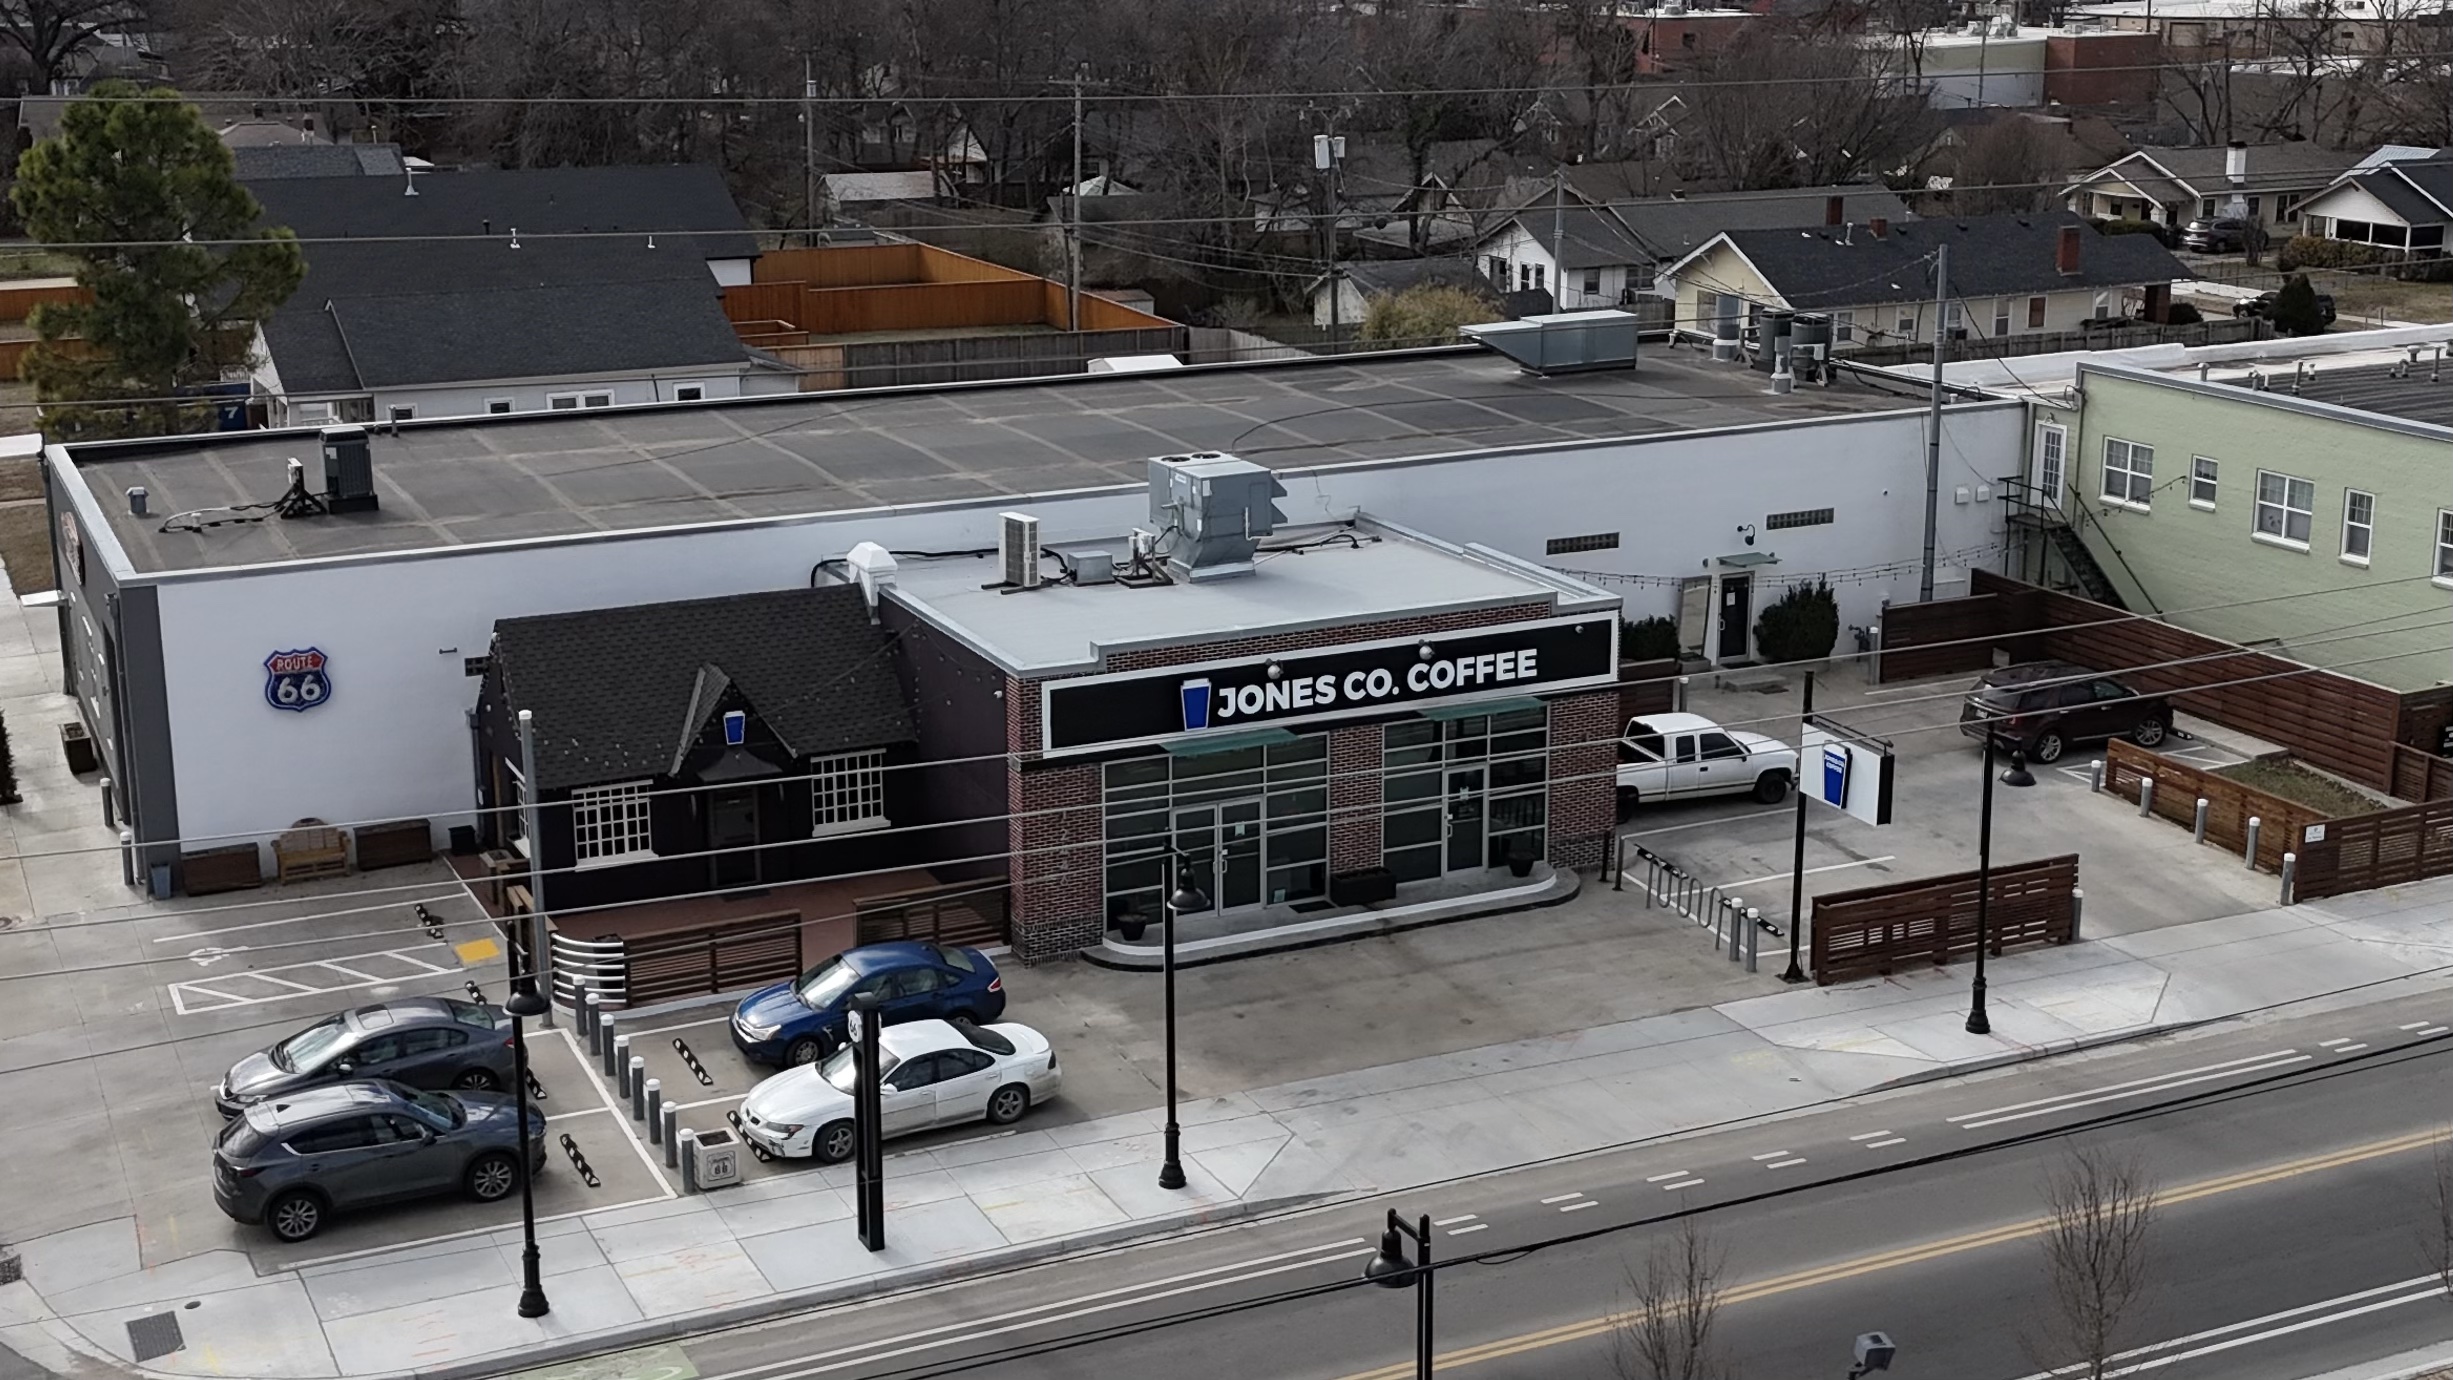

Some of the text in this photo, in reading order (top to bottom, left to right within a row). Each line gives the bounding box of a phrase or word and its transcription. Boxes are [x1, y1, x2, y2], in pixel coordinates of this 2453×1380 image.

[224, 406, 239, 419] 7
[276, 656, 313, 671] ROUTE
[277, 674, 321, 704] 66
[1217, 648, 1538, 718] JONES CO. COFFEE
